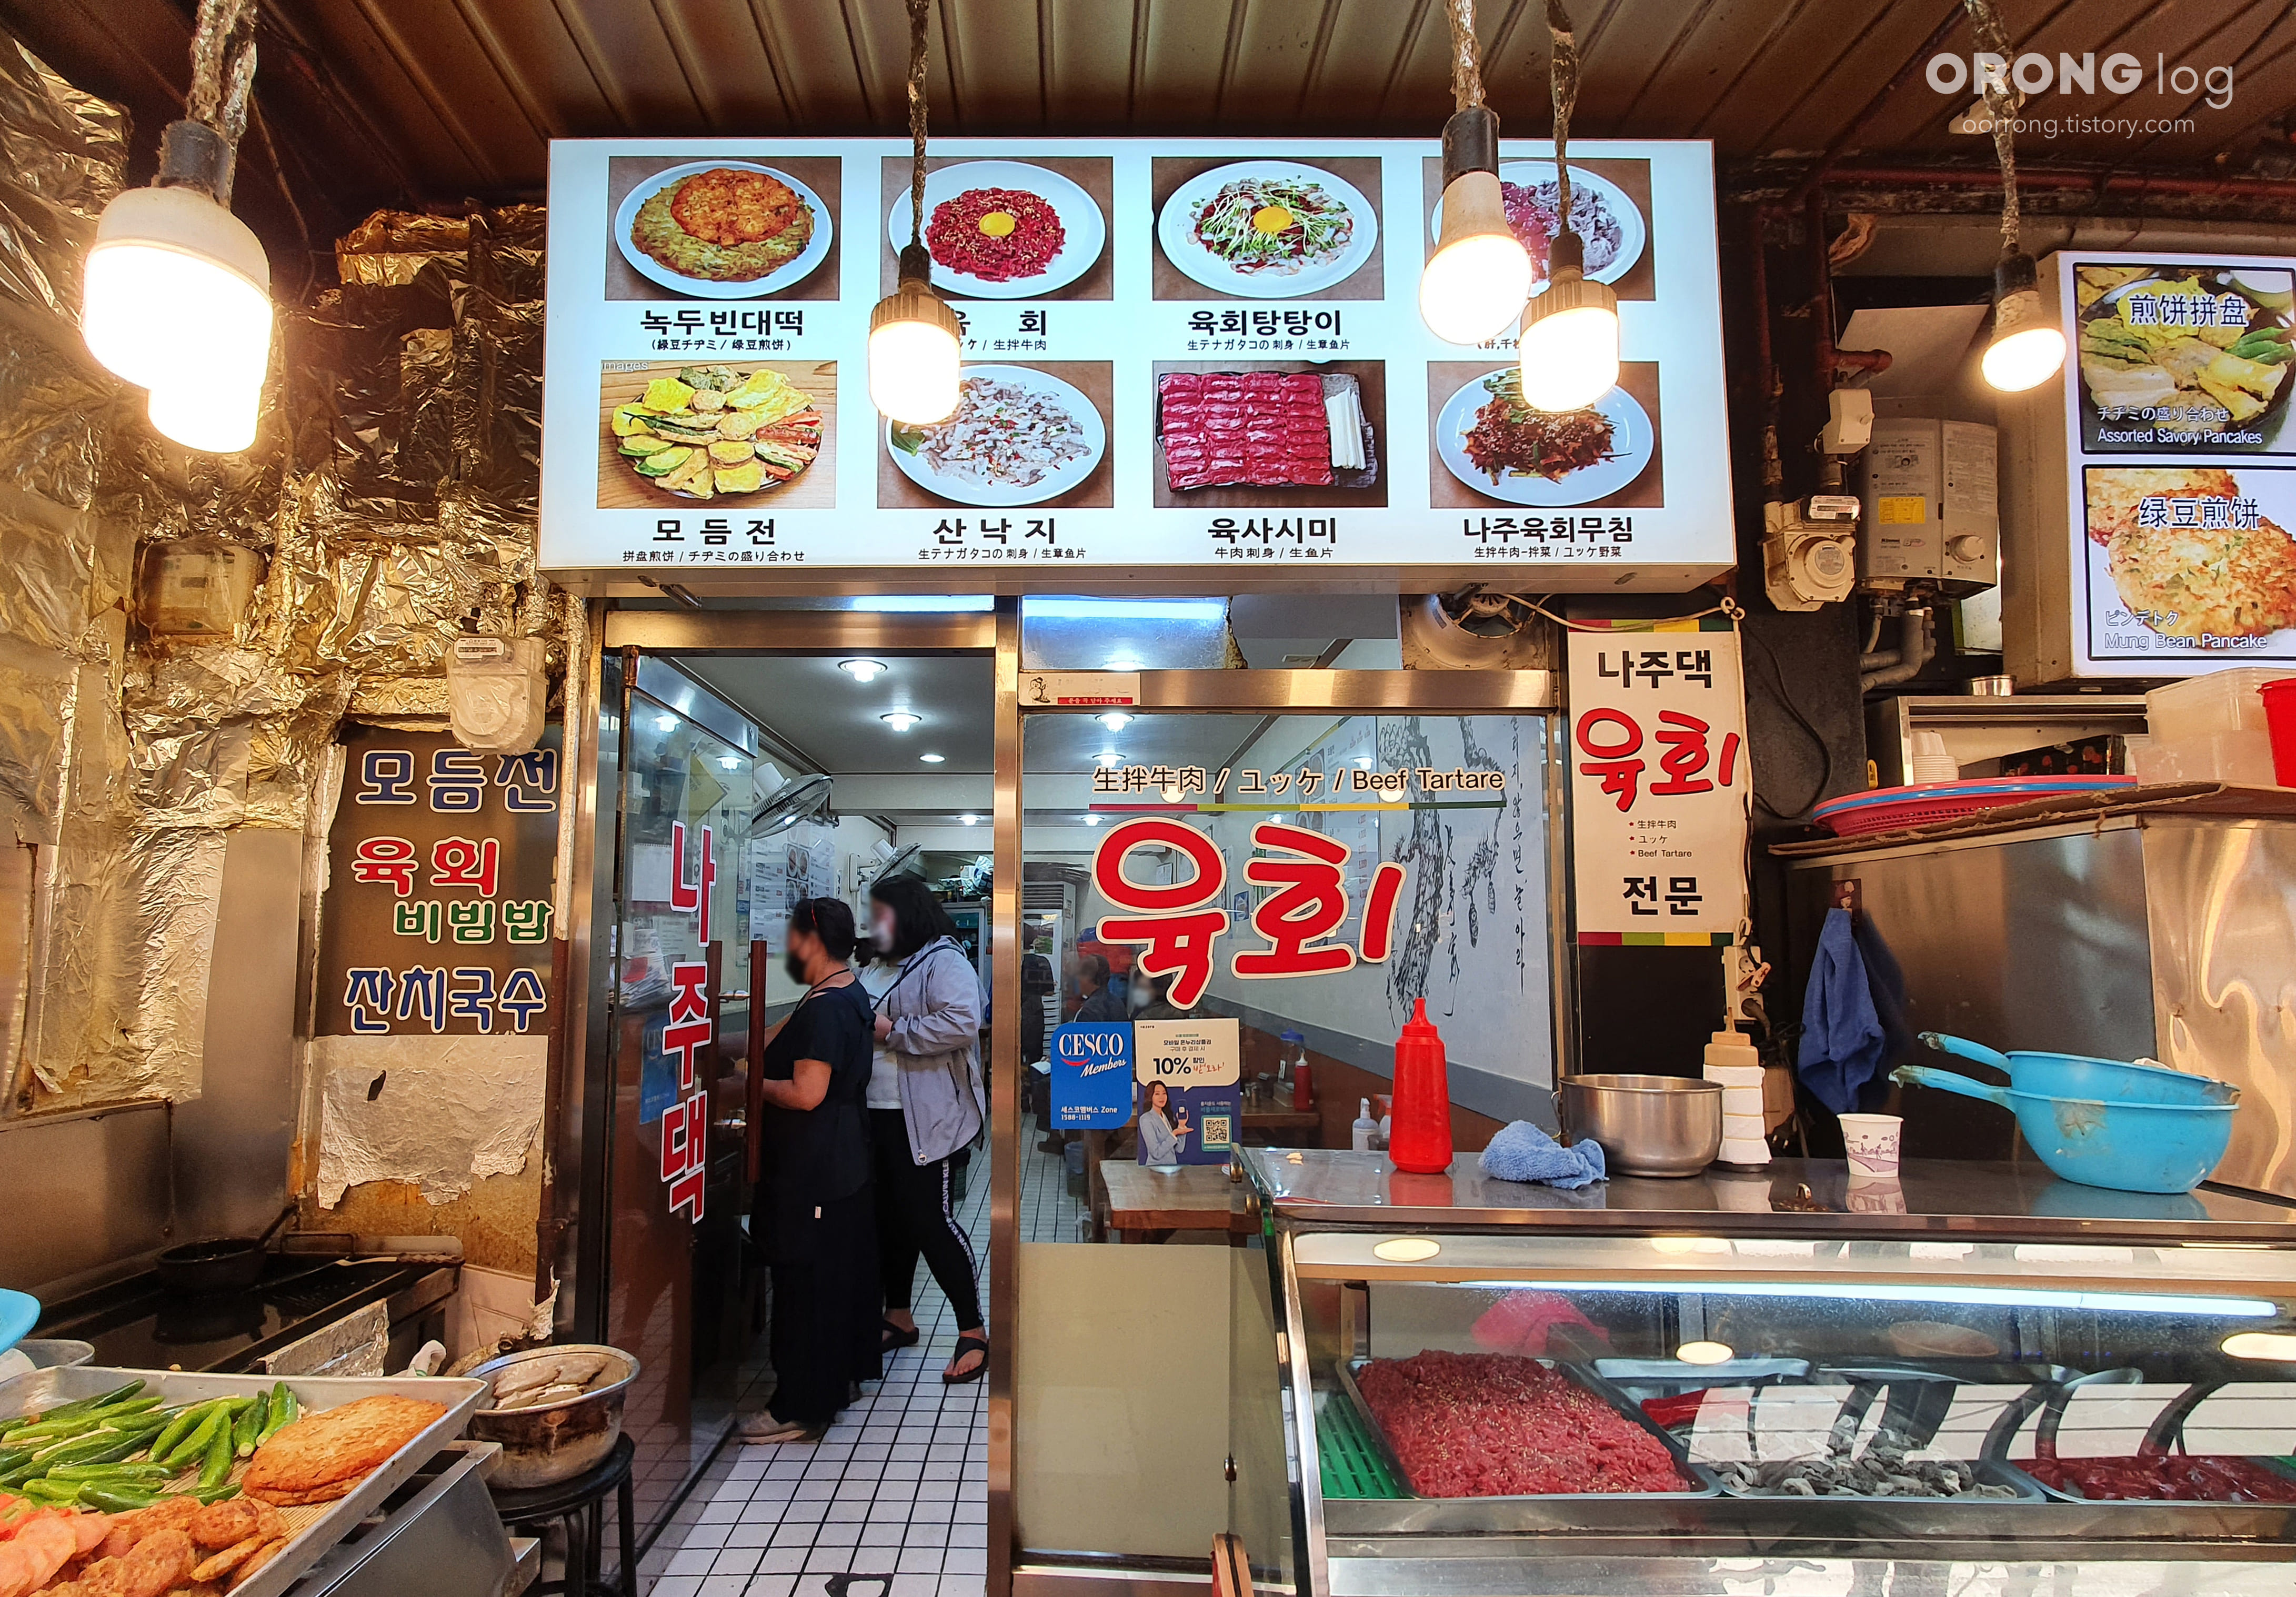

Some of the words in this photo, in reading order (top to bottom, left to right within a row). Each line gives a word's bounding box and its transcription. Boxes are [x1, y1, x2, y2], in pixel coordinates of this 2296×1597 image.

[640, 310, 803, 335] 녹두빈대떡
[2129, 293, 2248, 326] 煎饼拼盘
[1188, 310, 1340, 336] 육회탕탕이
[994, 339, 1047, 351] 生拌牛肉
[2097, 406, 2229, 421] チヂミの盛り合わせ
[2098, 428, 2153, 443] Assorted
[2157, 429, 2201, 446] Savory
[2204, 429, 2263, 445] Pancakes
[2139, 497, 2261, 529] 绿豆煎饼
[1208, 518, 1336, 544] 육사시미
[1463, 517, 1632, 543] 나주육회무침
[688, 550, 805, 562] チヂミの盛り合わせ
[1289, 548, 1334, 558] 生鱼片
[2105, 633, 2150, 650] Mung
[2155, 633, 2196, 649] Bean
[2201, 633, 2268, 649] Pancake
[1598, 649, 1712, 689] 나주댁
[1576, 708, 1740, 812] 육회
[1092, 766, 1205, 794] 生拌牛肉
[1238, 768, 1325, 795] ユッケ
[1351, 769, 1409, 792] Beef
[1417, 767, 1506, 791] Tartare
[1637, 820, 1677, 829] 生拌牛肉
[351, 836, 500, 898] 육회
[1622, 876, 1703, 916] 전문
[393, 900, 555, 944] 비빔밥
[1091, 816, 1407, 1010] 육회
[343, 964, 547, 1033] 잔치국수
[1059, 1033, 1124, 1056] CESCO
[1080, 1057, 1127, 1078] Members
[1153, 1057, 1191, 1074] 10%
